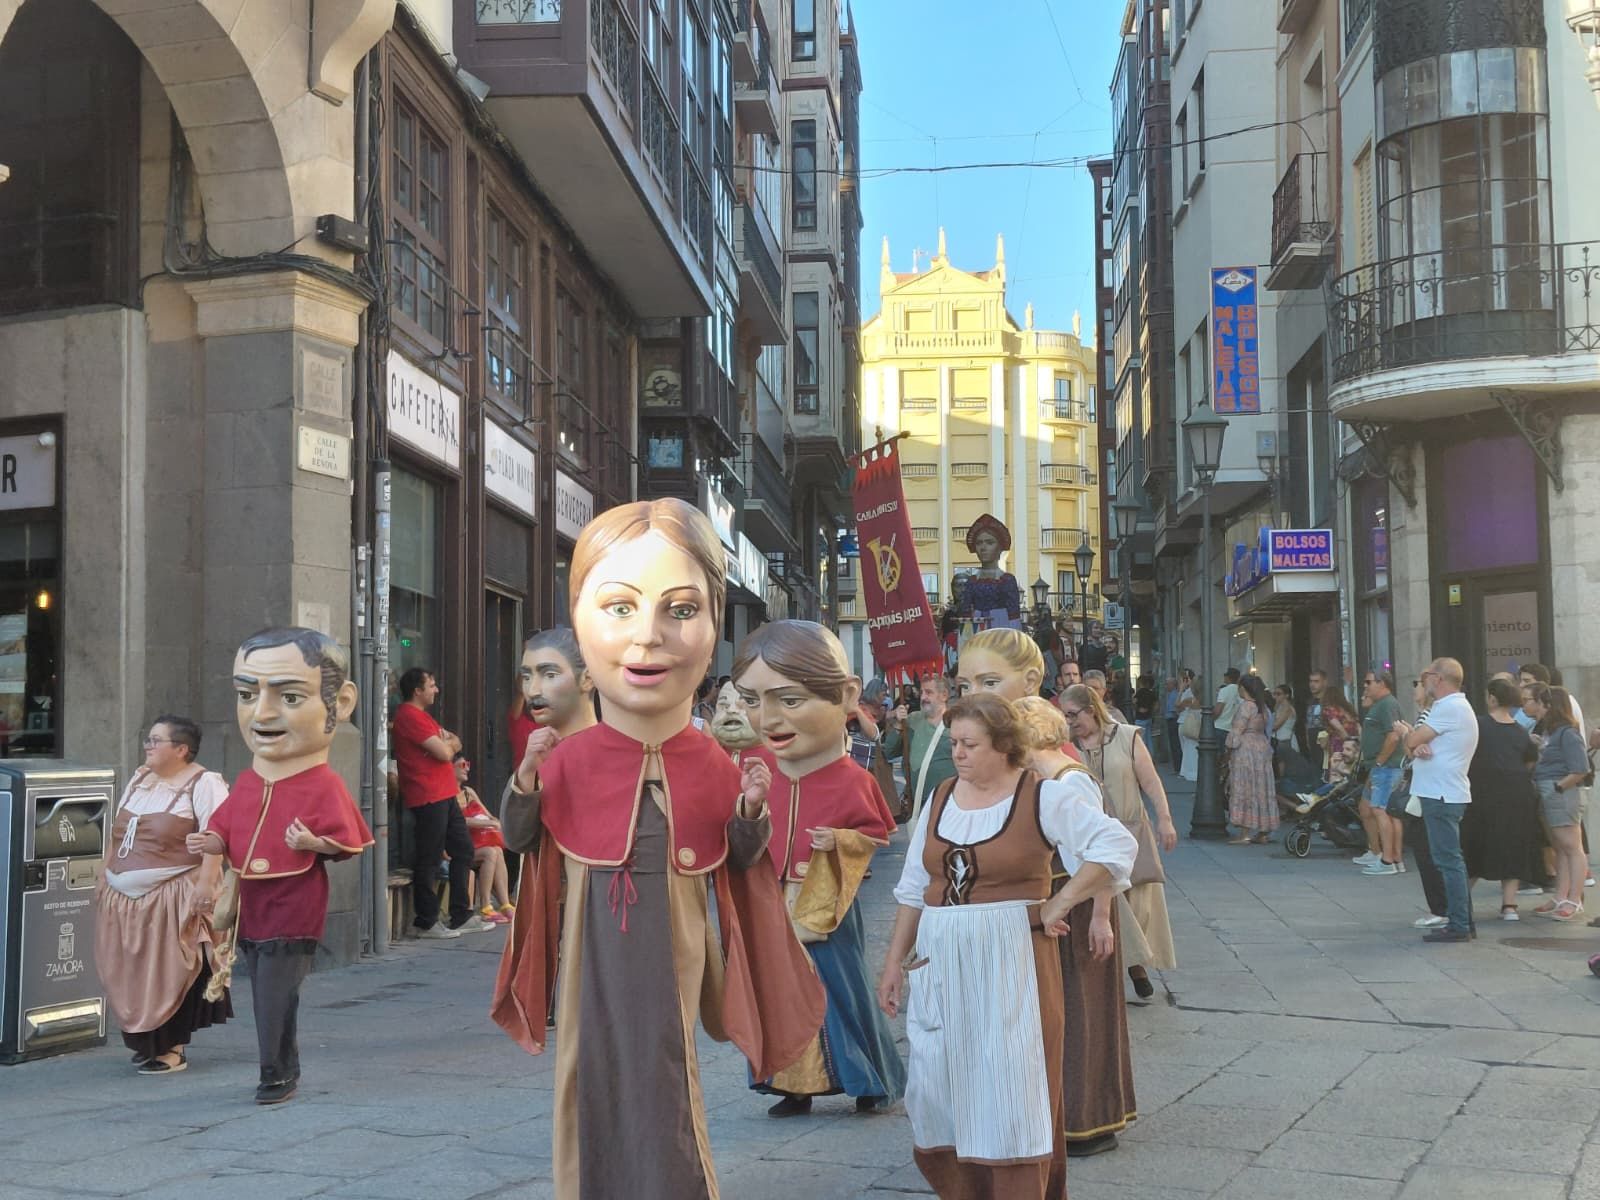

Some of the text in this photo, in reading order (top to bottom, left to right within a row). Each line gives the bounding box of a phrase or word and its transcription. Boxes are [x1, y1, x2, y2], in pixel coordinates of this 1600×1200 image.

[1216, 305, 1235, 411] MALETAS
[1237, 304, 1258, 410] BOLSOS
[316, 437, 336, 449] CALLE
[327, 449, 336, 460] LA
[2, 453, 17, 493] R
[498, 447, 515, 482] PLAZA
[1275, 535, 1326, 549] BOLSOS
[1273, 553, 1330, 567] MALETAS
[46, 960, 84, 977] ZAMORA
